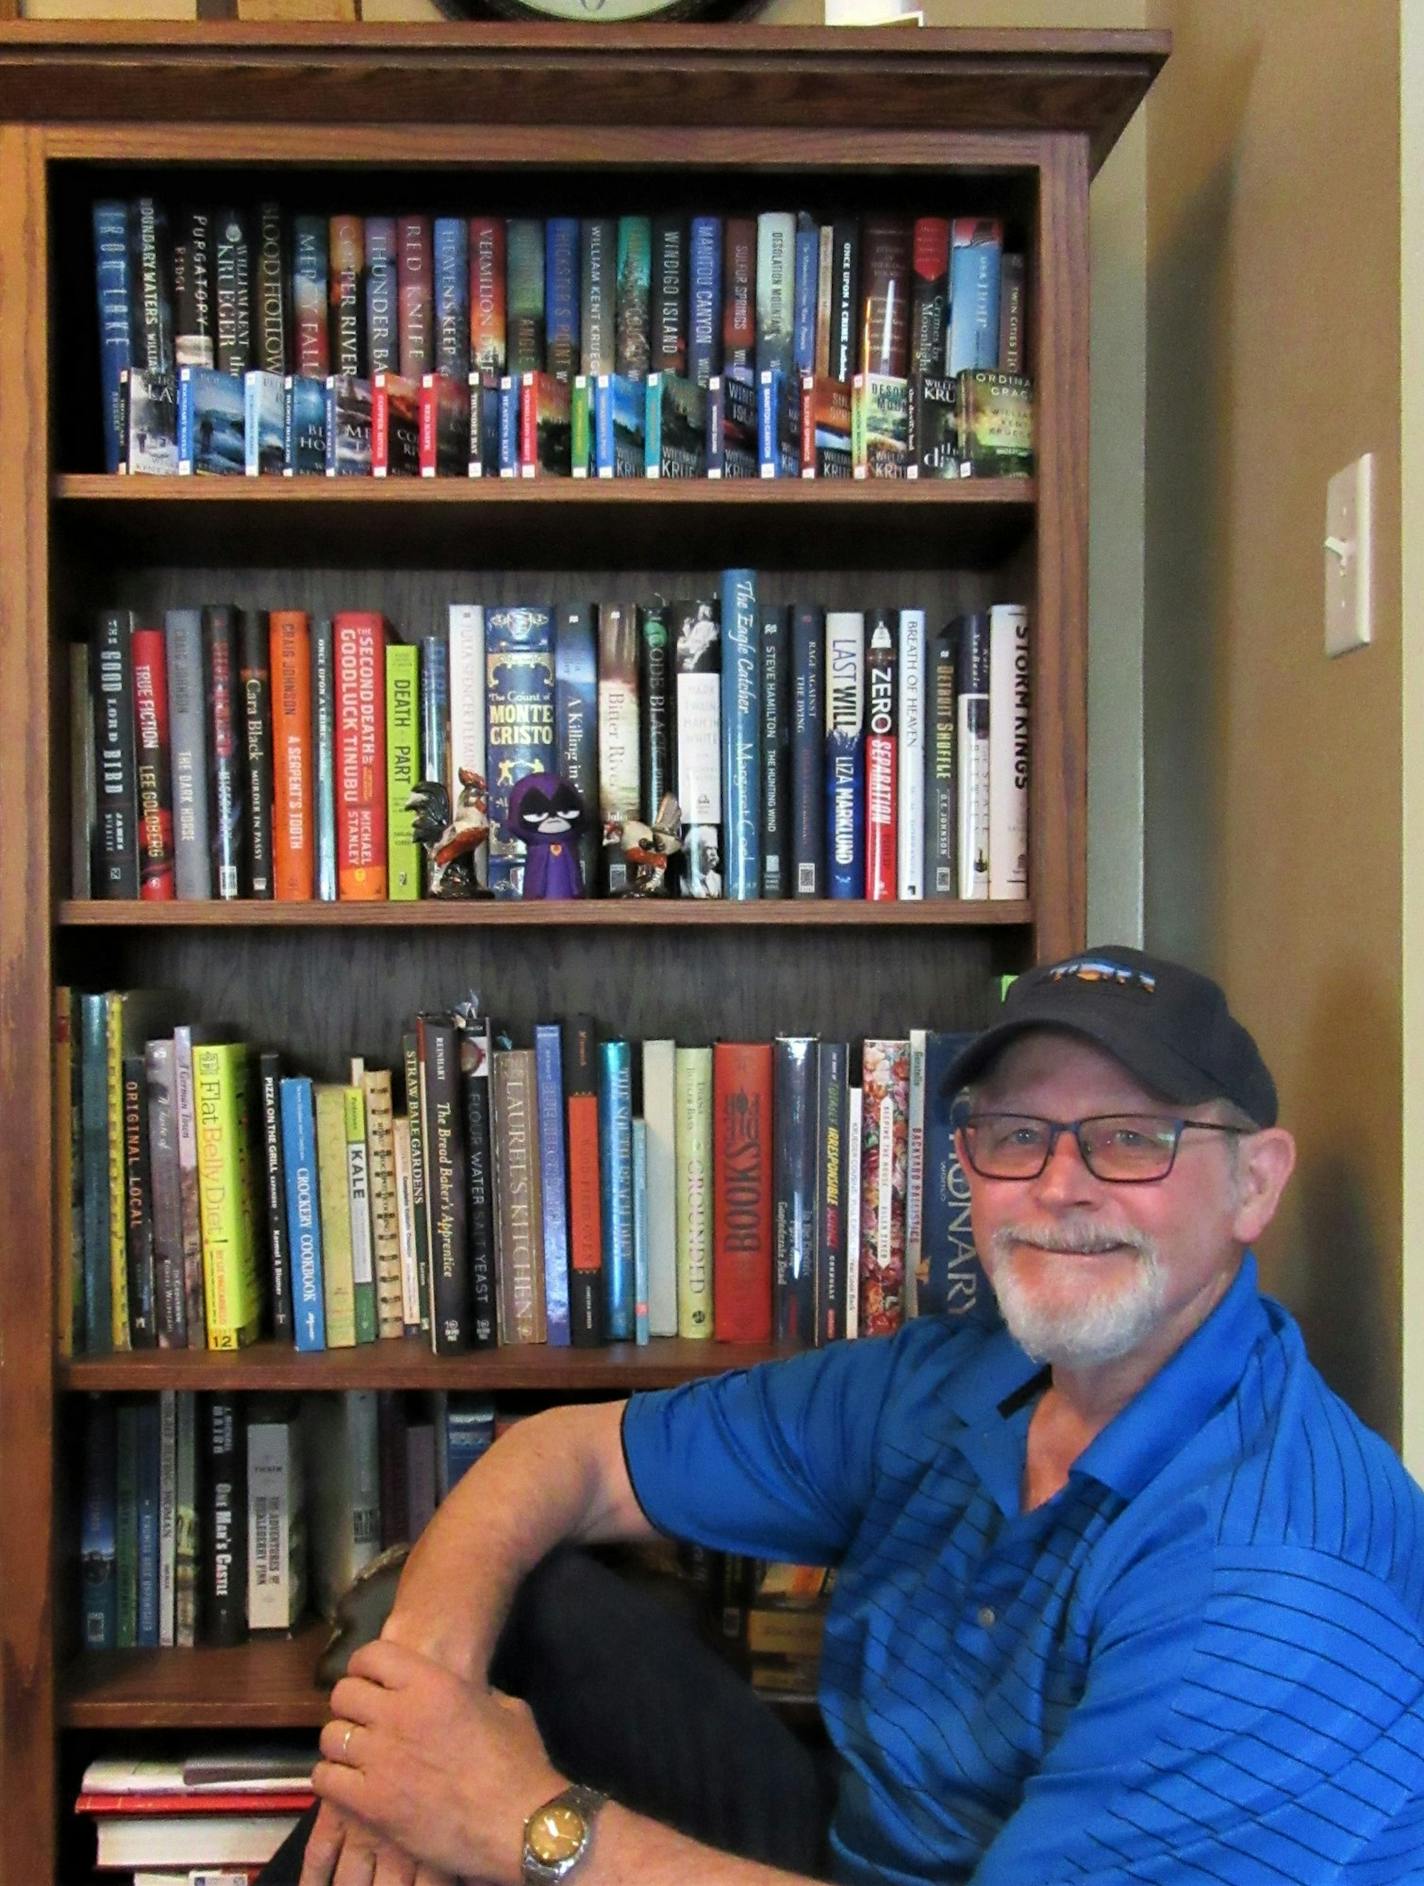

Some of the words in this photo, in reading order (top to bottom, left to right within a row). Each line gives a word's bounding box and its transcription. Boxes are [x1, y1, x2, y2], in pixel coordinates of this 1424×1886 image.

[406, 225, 422, 272] RED
[591, 226, 601, 282] WILLIAM
[663, 231, 680, 295] WINDIGO
[843, 242, 852, 269] ONCE
[192, 215, 208, 328] PURGATORY
[236, 243, 250, 305] WILLIAM
[372, 236, 388, 341] THUNDER
[842, 271, 851, 299] UPON
[103, 289, 130, 346] LAKE
[144, 271, 159, 325] WATERS
[217, 243, 236, 348] KRUEGER
[591, 286, 601, 321] KENT
[696, 290, 712, 345] CANYON
[841, 301, 849, 309] A
[238, 309, 250, 348] KENT
[264, 282, 283, 372] HOLLOW
[406, 286, 424, 361] KNIFE
[442, 316, 456, 356] KEEP
[662, 302, 679, 354] ISLAND
[840, 311, 849, 343] CRIME
[915, 303, 934, 373] Moonlight
[931, 295, 946, 342] Crimes
[341, 316, 358, 376] RIVER
[930, 347, 942, 362] by
[976, 373, 1031, 387] ORDINA
[470, 393, 479, 435] THUNDER
[470, 437, 478, 456] BAY
[735, 580, 753, 610] The
[108, 620, 116, 644] THE
[282, 623, 296, 657] CRAIG
[728, 614, 754, 654] Eagle
[808, 641, 816, 668] RAGE
[906, 620, 918, 670] BREATH
[101, 652, 122, 692] GOOD
[136, 665, 152, 696] TRUE
[340, 628, 356, 731] GOODLUCK
[359, 637, 374, 701] SECOND
[649, 635, 665, 689] CODE
[766, 646, 776, 680] STEVE
[832, 639, 857, 682] LAST
[1015, 624, 1030, 709] STORM
[245, 679, 261, 715] Cara
[284, 662, 296, 716] JOHNSON
[394, 679, 410, 727] DEATH
[506, 690, 537, 702] Count
[568, 696, 582, 706] A
[737, 659, 755, 714] Catcher
[796, 676, 805, 694] THE
[808, 672, 816, 718] AGAINST
[871, 667, 892, 734] ZERO
[907, 675, 918, 694] OF
[936, 666, 953, 716] DETROIT
[108, 699, 118, 742] LORD
[140, 701, 159, 748] FICTION
[361, 704, 374, 754] DEATH
[488, 704, 554, 725] MONTE
[607, 693, 624, 739] Bitter
[649, 695, 665, 761] BLACK
[766, 683, 776, 738] HAMILTON
[796, 697, 805, 733] DYING
[832, 686, 857, 730] WILL
[906, 698, 918, 748] HEAVEN
[248, 720, 263, 760] Black
[288, 736, 300, 744] A
[489, 725, 554, 746] CRISTO
[564, 712, 584, 761] Killing
[768, 750, 776, 766] THE
[936, 723, 954, 779] SHUFFLE
[1015, 716, 1030, 790] KINGS
[103, 750, 123, 793] BIRD
[140, 765, 155, 788] LEE
[178, 752, 191, 772] THE
[289, 747, 302, 808] SERPENT'S
[343, 736, 359, 802] TINUBU
[394, 746, 410, 785] PART
[568, 764, 582, 778] in
[609, 745, 625, 790] River
[733, 743, 753, 817] Margaret
[835, 756, 854, 785] LIZA
[872, 740, 891, 824] SEPARATION
[179, 775, 192, 802] DARK
[251, 770, 260, 813] MURDER
[768, 768, 776, 806] HUNTING
[116, 812, 124, 850] JAMES
[142, 792, 163, 857] GOLDBERG
[180, 808, 195, 841] HORSE
[254, 816, 261, 827] IN
[290, 811, 303, 849] TOOTH
[347, 810, 358, 865] STANLEY
[360, 810, 372, 865] MICHAEL
[735, 819, 754, 861] Coel
[767, 808, 776, 832] WIND
[835, 788, 854, 864] MARKLUND
[940, 812, 948, 856] JOHNSON
[254, 830, 262, 860] PASSY
[406, 1050, 420, 1099] STRAW
[436, 1037, 445, 1081] REINHART
[200, 1080, 221, 1125] Flat
[264, 1077, 275, 1106] PIZZA
[266, 1108, 276, 1120] ON
[125, 1081, 141, 1165] ORIGINAL
[267, 1121, 277, 1142] THE
[409, 1101, 422, 1135] BALE
[437, 1103, 451, 1126] The
[469, 1094, 482, 1146] FLOUR
[203, 1127, 223, 1188] Belly
[268, 1144, 277, 1173] GRILL
[438, 1128, 452, 1165] Bread
[505, 1081, 527, 1195] LAUREL'S
[911, 1128, 923, 1181] BACKYARD
[351, 1150, 365, 1199] KALE
[411, 1138, 423, 1205] GARDENS
[439, 1167, 453, 1211] Baker's
[471, 1152, 483, 1205] WATER
[827, 1126, 839, 1207] IRRESPONSIBLE
[128, 1177, 143, 1229] LOCAL
[270, 1175, 278, 1209] EXPANDED
[295, 1168, 313, 1229] CROCKERY
[725, 1141, 761, 1252] BOOKS
[910, 1185, 922, 1244] BALLISTICS
[204, 1184, 228, 1246] Diet!
[473, 1210, 486, 1248] SALT
[687, 1159, 705, 1294] GROUNDED
[438, 1213, 454, 1277] Apprentice
[510, 1204, 532, 1319] KITCHEN
[274, 1267, 284, 1296] Blumer
[299, 1234, 315, 1302] COOKBOOK
[475, 1254, 488, 1303] YEAST
[213, 1335, 233, 1348] 12
[255, 1496, 269, 1563] HUCKLEBERRY
[268, 1513, 281, 1572] ADVENTURES
[256, 1564, 268, 1586] FINN
